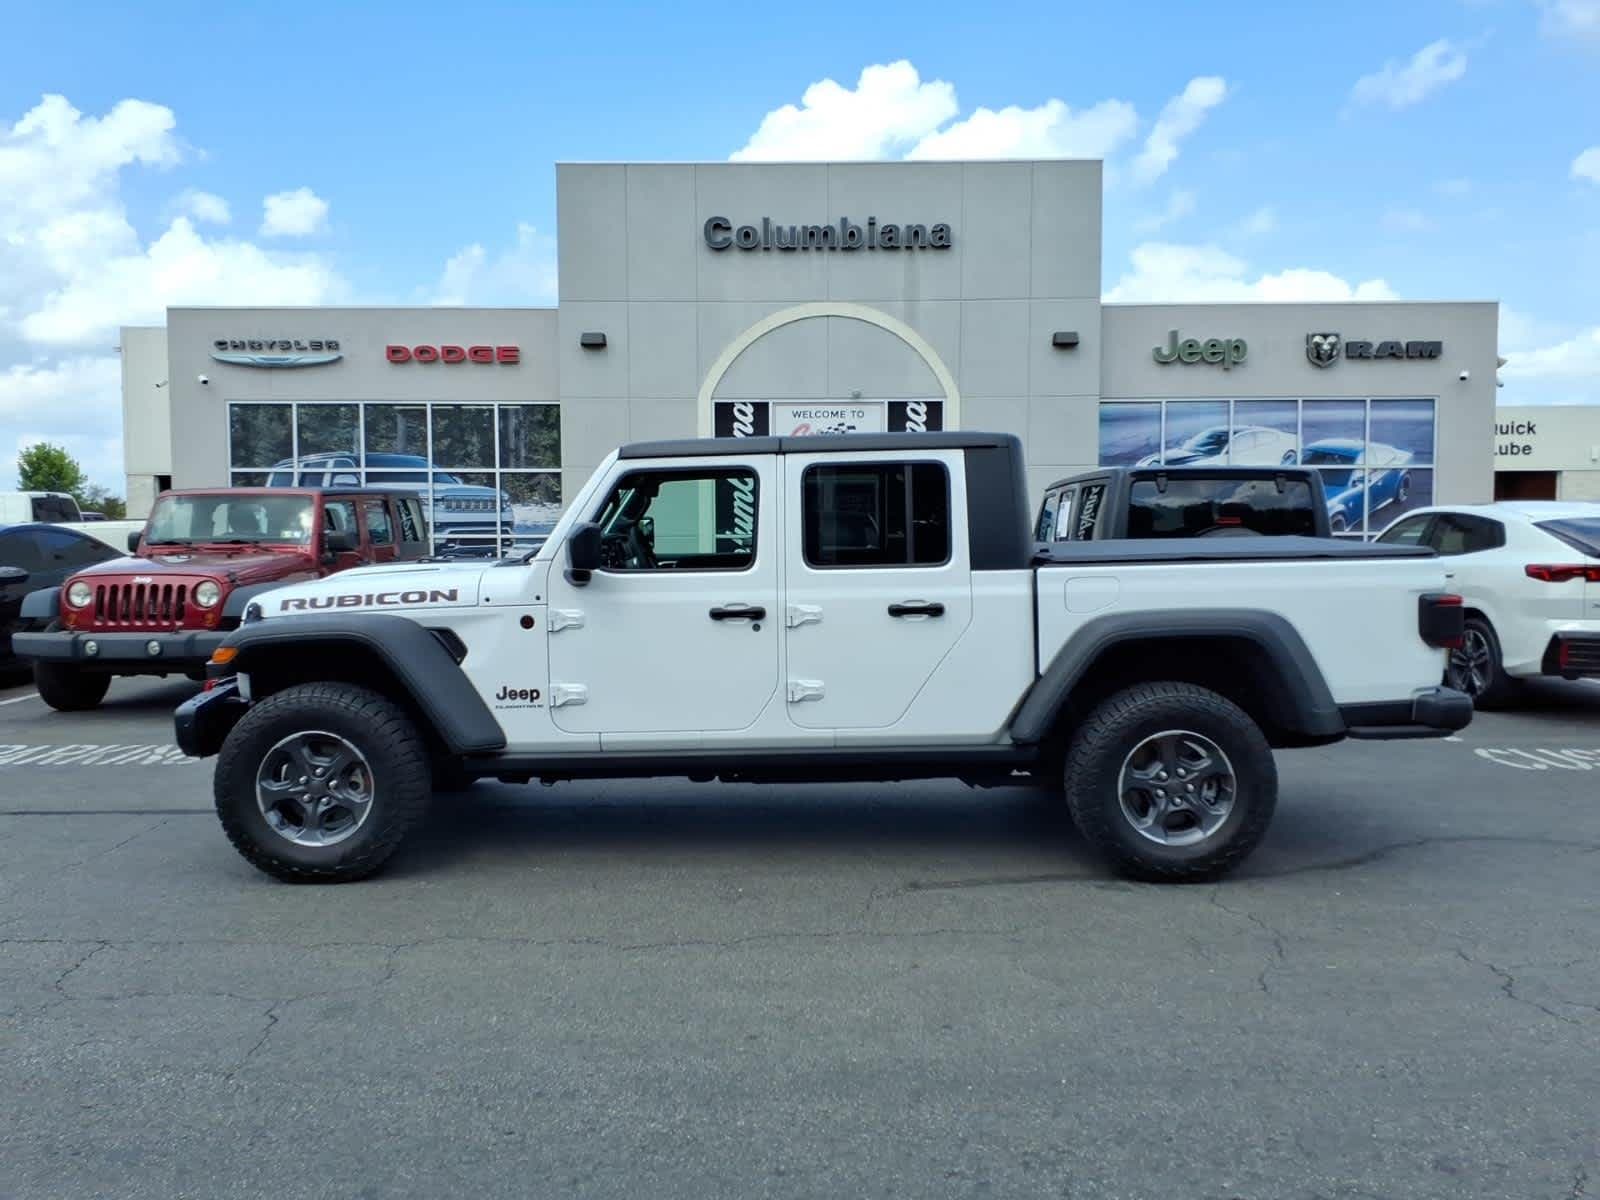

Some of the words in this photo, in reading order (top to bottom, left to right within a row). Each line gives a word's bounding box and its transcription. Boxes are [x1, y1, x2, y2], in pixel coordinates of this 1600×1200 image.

[703, 216, 952, 250] Columbiana
[213, 339, 340, 351] CHRYSLER
[1152, 330, 1248, 370] Jeep
[1345, 341, 1443, 360] RAM
[386, 345, 521, 364] DODGE
[792, 409, 846, 419] WELCOME
[850, 409, 865, 419] TO
[1494, 420, 1537, 435] uick
[1493, 442, 1533, 456] ube
[280, 589, 459, 611] RUBICON
[495, 686, 541, 703] Jeep
